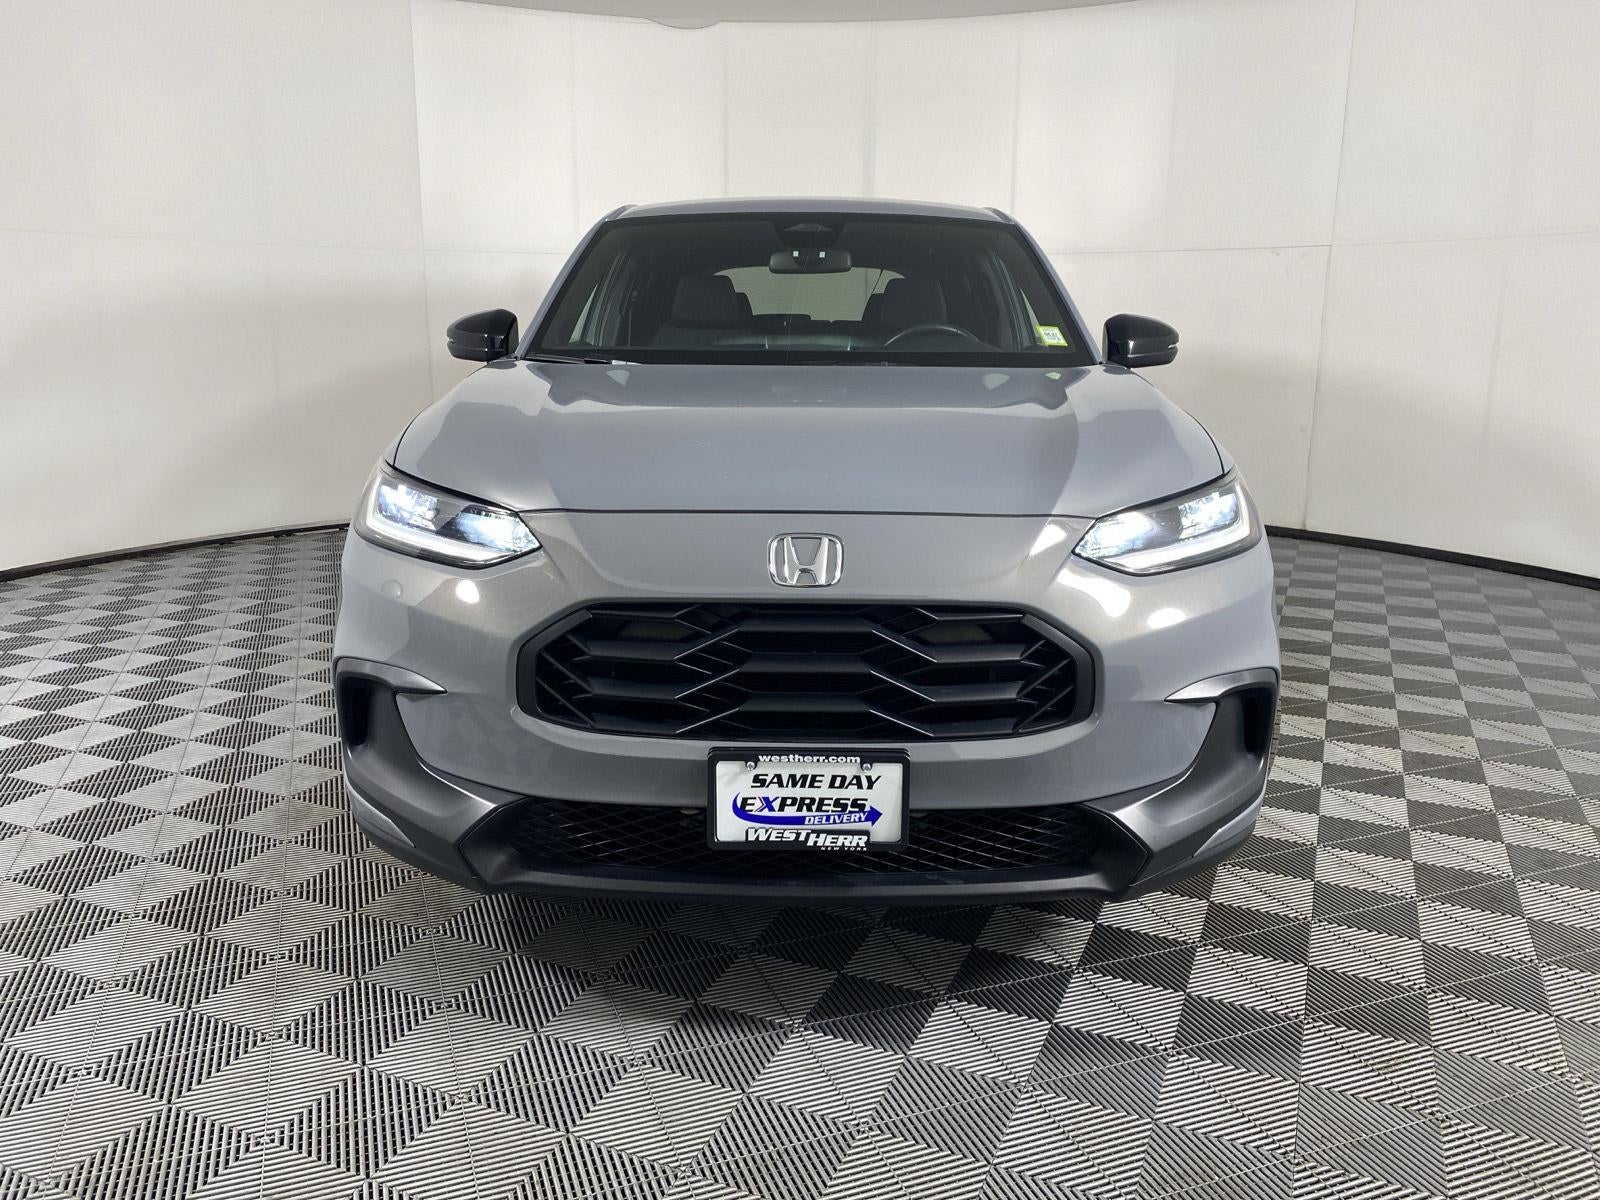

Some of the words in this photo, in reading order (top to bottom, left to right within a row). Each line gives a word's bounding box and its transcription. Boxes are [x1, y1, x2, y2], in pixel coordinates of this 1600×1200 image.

[758, 754, 861, 764] westherr.com
[751, 773, 824, 789] SAME
[828, 774, 882, 790] DAY
[739, 796, 868, 813] EXPRESS
[804, 812, 868, 825] DELIVERY
